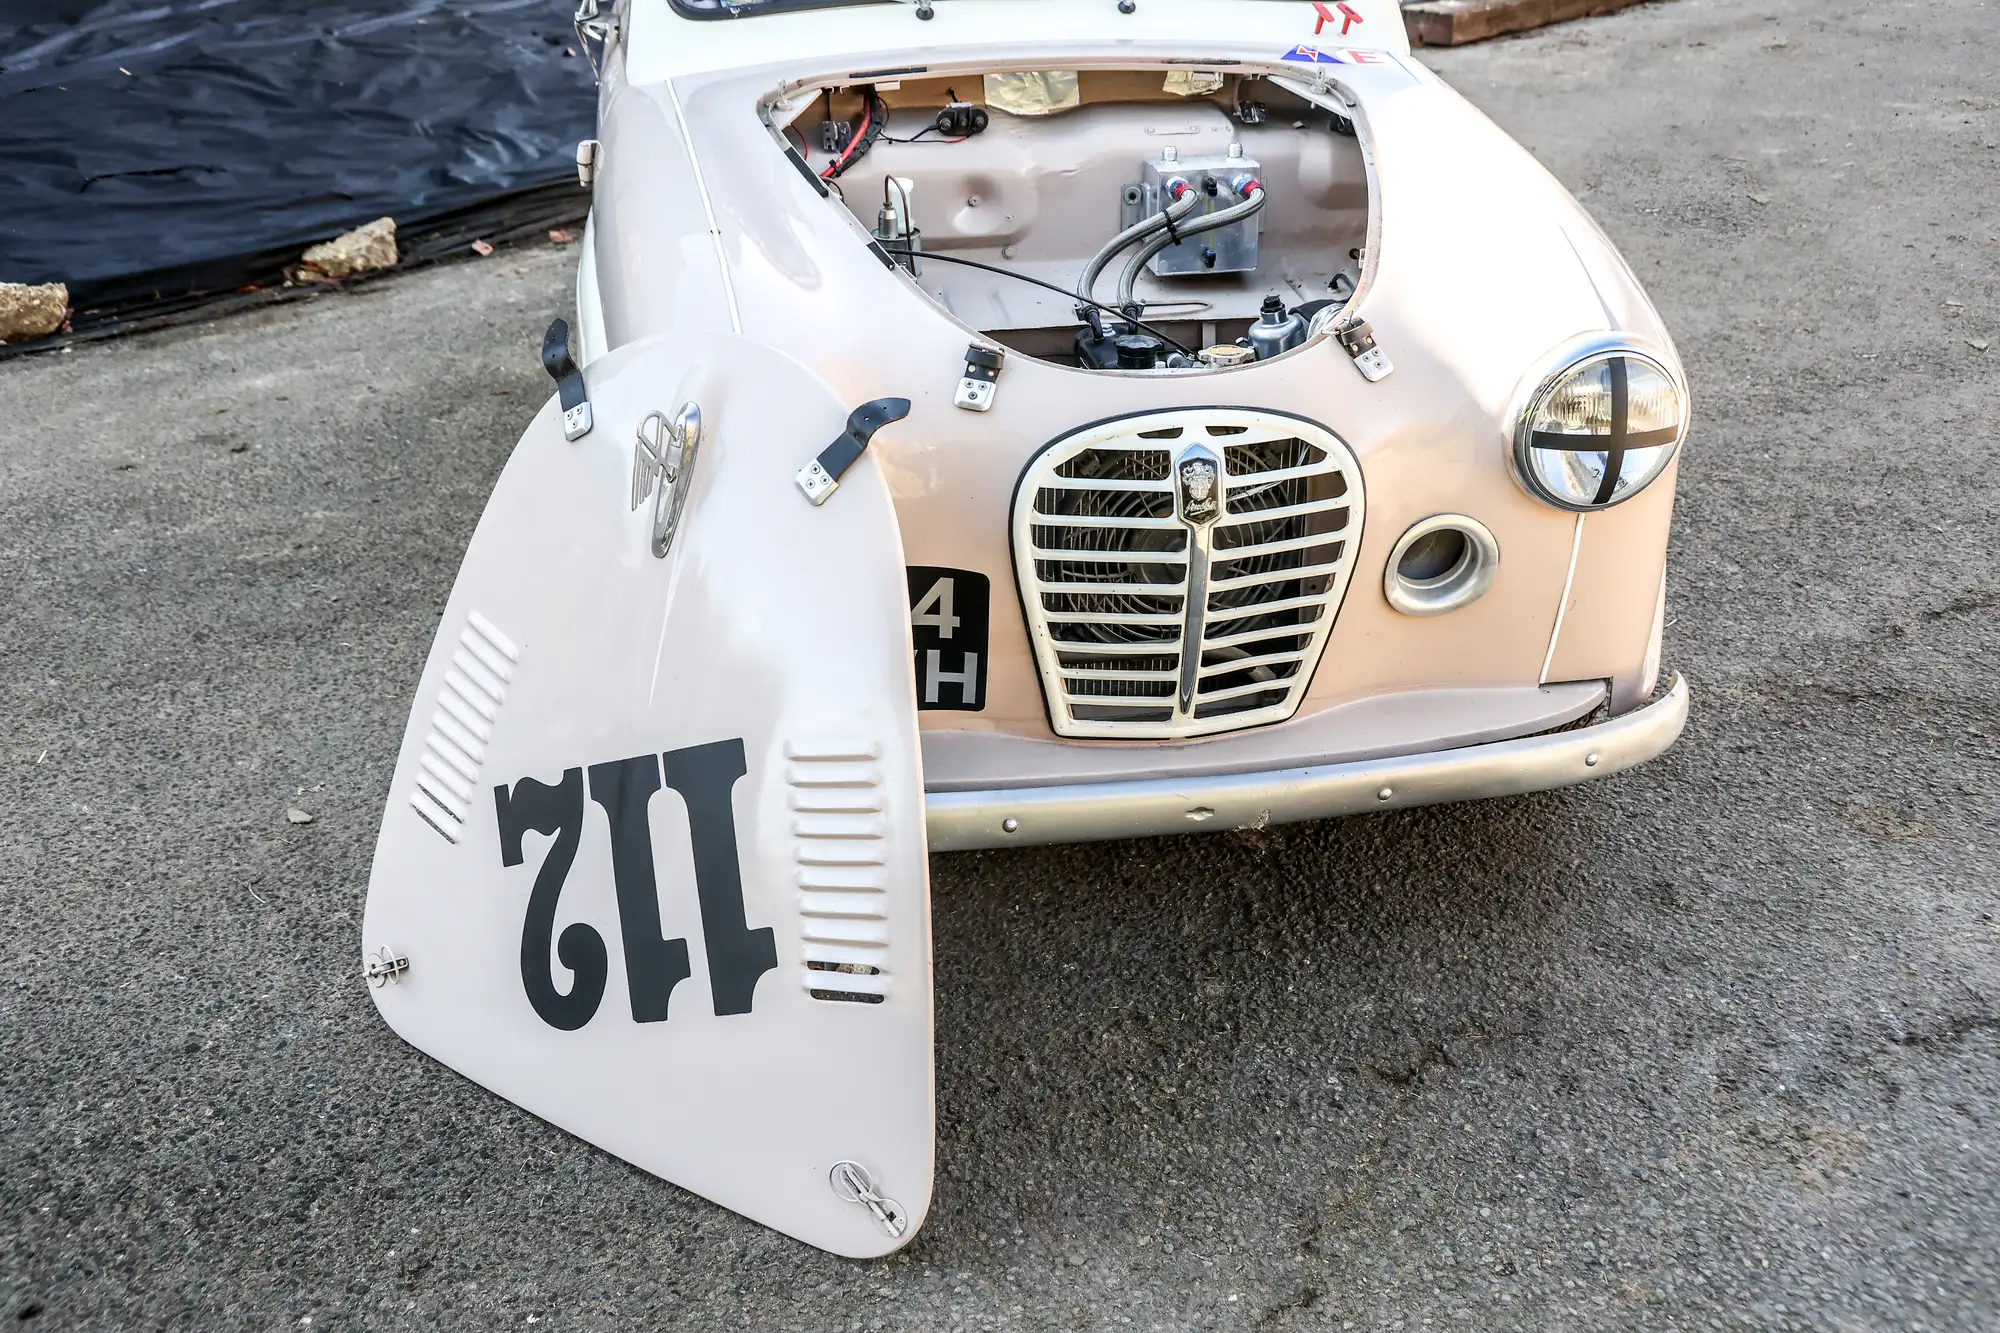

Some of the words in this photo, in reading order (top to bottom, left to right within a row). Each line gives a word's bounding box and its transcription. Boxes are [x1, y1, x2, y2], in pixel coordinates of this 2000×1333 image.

[911, 577, 960, 639] 4
[914, 649, 978, 704] H
[493, 737, 778, 1032] 112
